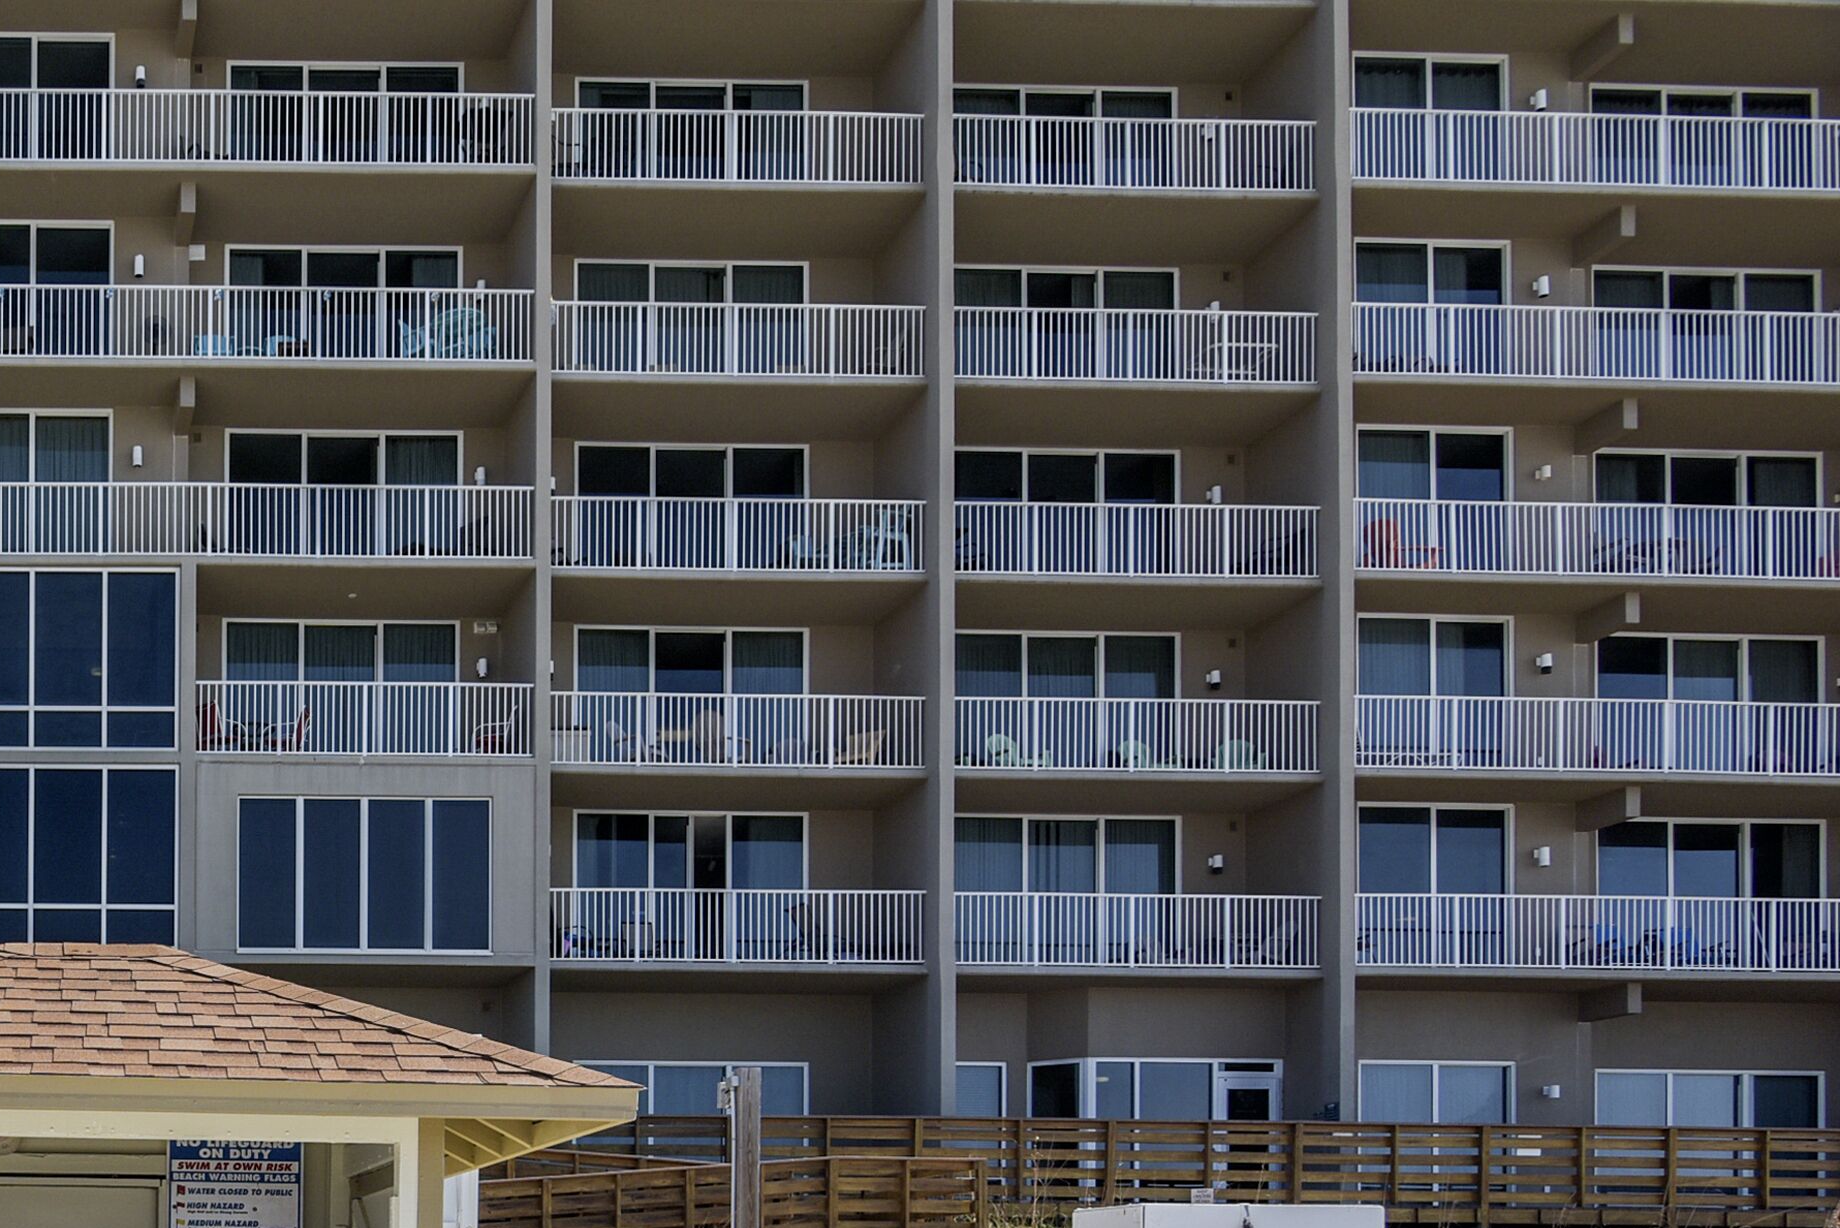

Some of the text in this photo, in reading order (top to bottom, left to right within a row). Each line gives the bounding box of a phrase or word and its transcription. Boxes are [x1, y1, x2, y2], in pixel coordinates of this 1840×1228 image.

[207, 1141, 294, 1149] LIFEGUARD
[199, 1149, 272, 1159] ON DUTY
[177, 1161, 293, 1171] SWIM AT OWN RISK
[209, 1173, 260, 1181] WARNING
[264, 1174, 296, 1182] FLAGS
[219, 1188, 248, 1196] CLOSED
